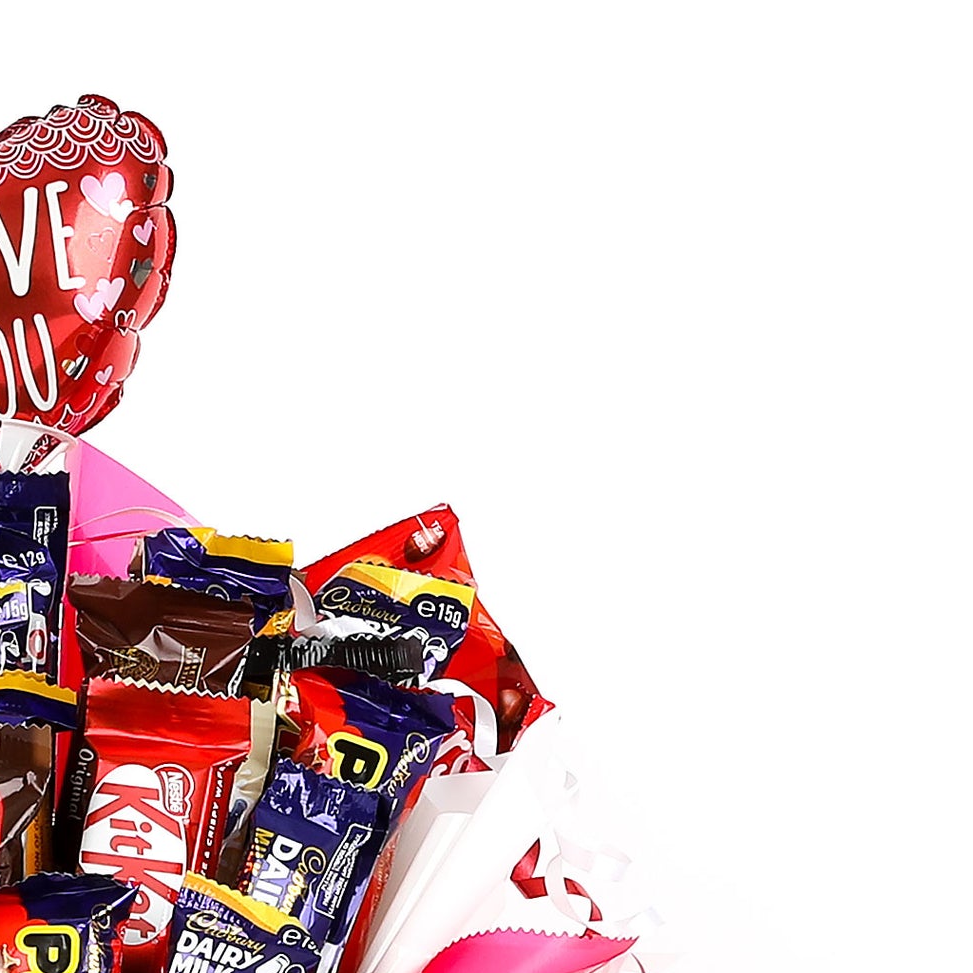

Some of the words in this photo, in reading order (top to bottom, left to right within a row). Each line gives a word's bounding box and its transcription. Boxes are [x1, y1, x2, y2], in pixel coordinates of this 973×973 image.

[3, 599, 28, 620] 15g
[321, 586, 402, 624] Cadbury
[437, 603, 462, 629] 15g
[176, 929, 265, 970] DAIRY
[187, 910, 267, 956] Cadbury
